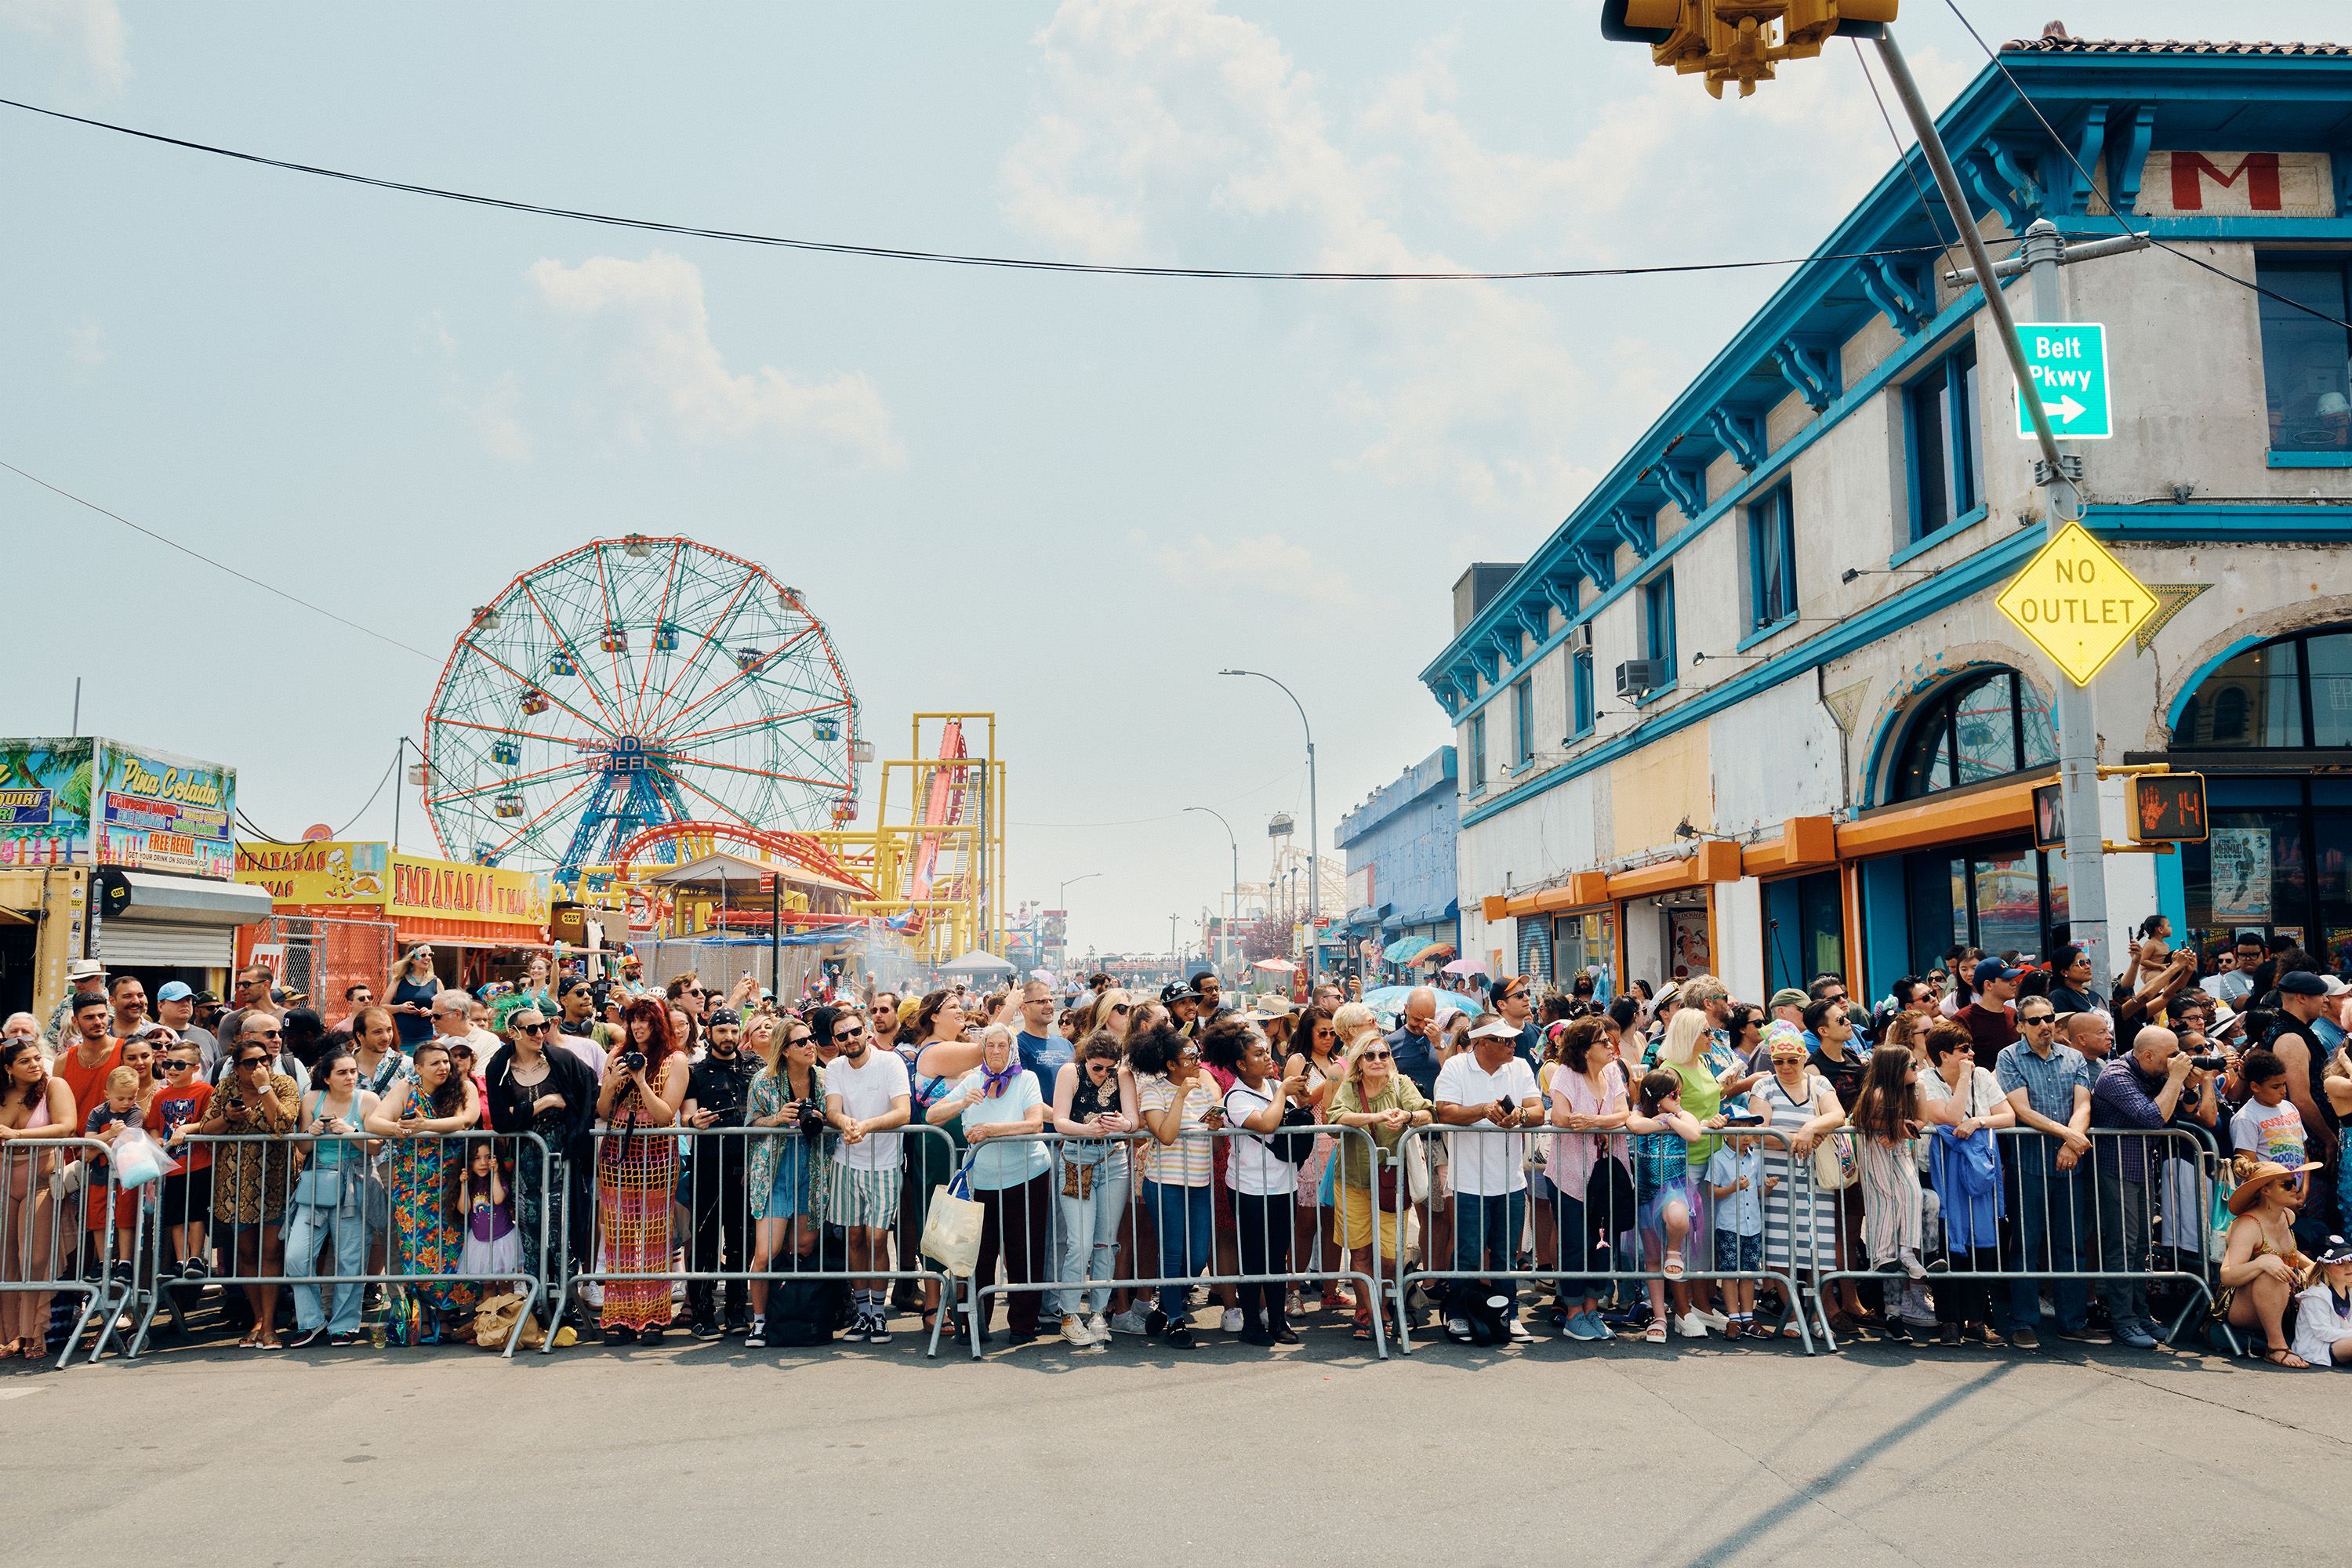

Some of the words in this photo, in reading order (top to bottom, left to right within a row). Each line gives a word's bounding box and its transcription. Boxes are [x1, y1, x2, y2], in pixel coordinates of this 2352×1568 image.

[2171, 151, 2281, 211] M
[2036, 337, 2082, 358] Belt
[2031, 365, 2091, 391] Pkwy
[2056, 559, 2095, 583] NO
[2021, 599, 2134, 624] OUTLET
[577, 738, 666, 752] WONDER
[586, 757, 654, 771] WHEEL
[162, 767, 218, 806] Colada
[109, 794, 151, 814] STRAWBERRY
[151, 802, 176, 817] DAQUIRI
[2179, 791, 2200, 827] 14
[117, 810, 134, 824] BLUE
[134, 813, 165, 829] HAWAIIAN
[172, 819, 194, 833] BANANA
[195, 822, 219, 836] DAQUIRI
[149, 833, 169, 853] FREE
[169, 836, 194, 855] REFILL
[176, 857, 198, 866] SOUVENIR
[235, 851, 326, 872] MPANADAS
[394, 864, 493, 913] EMPANADAS
[498, 887, 504, 913] Y
[507, 889, 527, 916] MAS
[2203, 935, 2229, 944] SIDESHOW
[161, 1098, 196, 1116] VENOM
[2260, 1115, 2285, 1129] GOOD
[2264, 1128, 2289, 1138] GOOD
[2270, 1144, 2294, 1155] GOOD
[2271, 1152, 2294, 1163] GOOD
